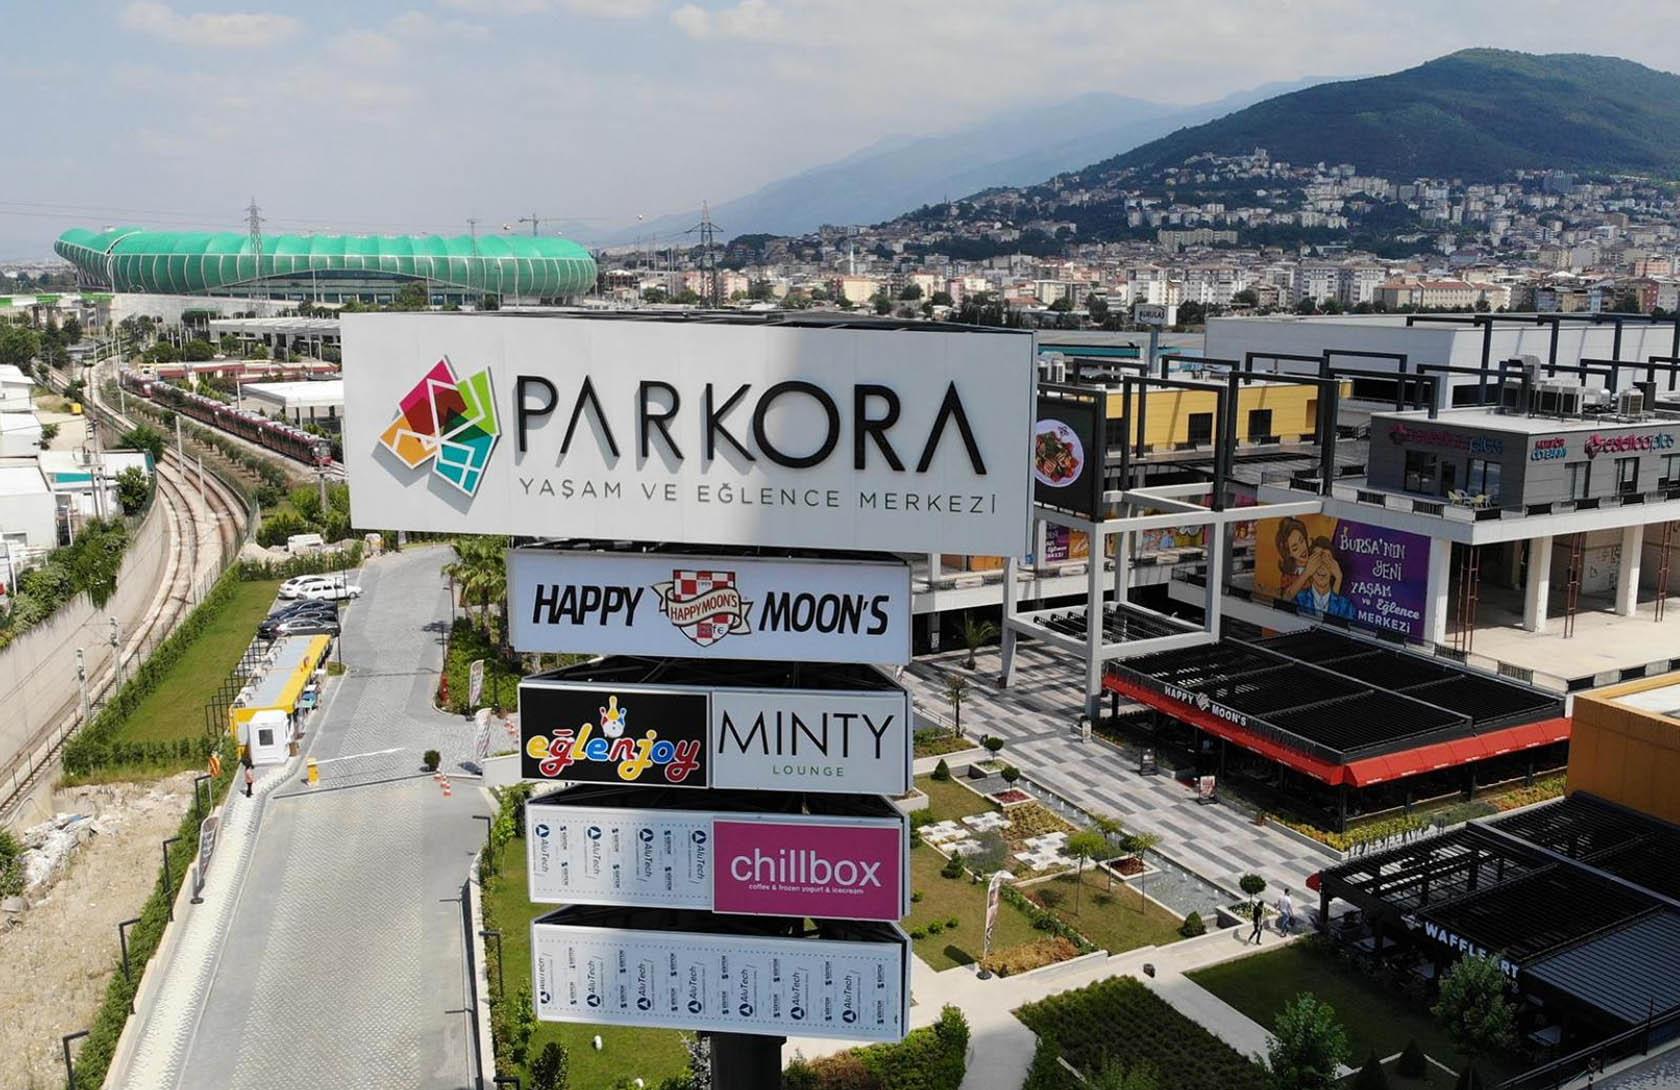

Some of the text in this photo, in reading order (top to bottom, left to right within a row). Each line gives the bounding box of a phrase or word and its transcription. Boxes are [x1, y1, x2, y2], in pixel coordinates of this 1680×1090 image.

[516, 374, 988, 476] PARKORA
[518, 477, 997, 515] YAŞAM VE EĞLENCE MERKEZİ
[532, 584, 890, 636] HAPPY MOON'S
[1358, 610, 1411, 633] MERKEZİ
[1164, 685, 1247, 727] HAPPY MOON'S
[718, 709, 895, 760] MINTY
[772, 764, 845, 778] LOUNGE
[730, 847, 882, 887] chillbox
[1424, 921, 1488, 962] WAFFLE
